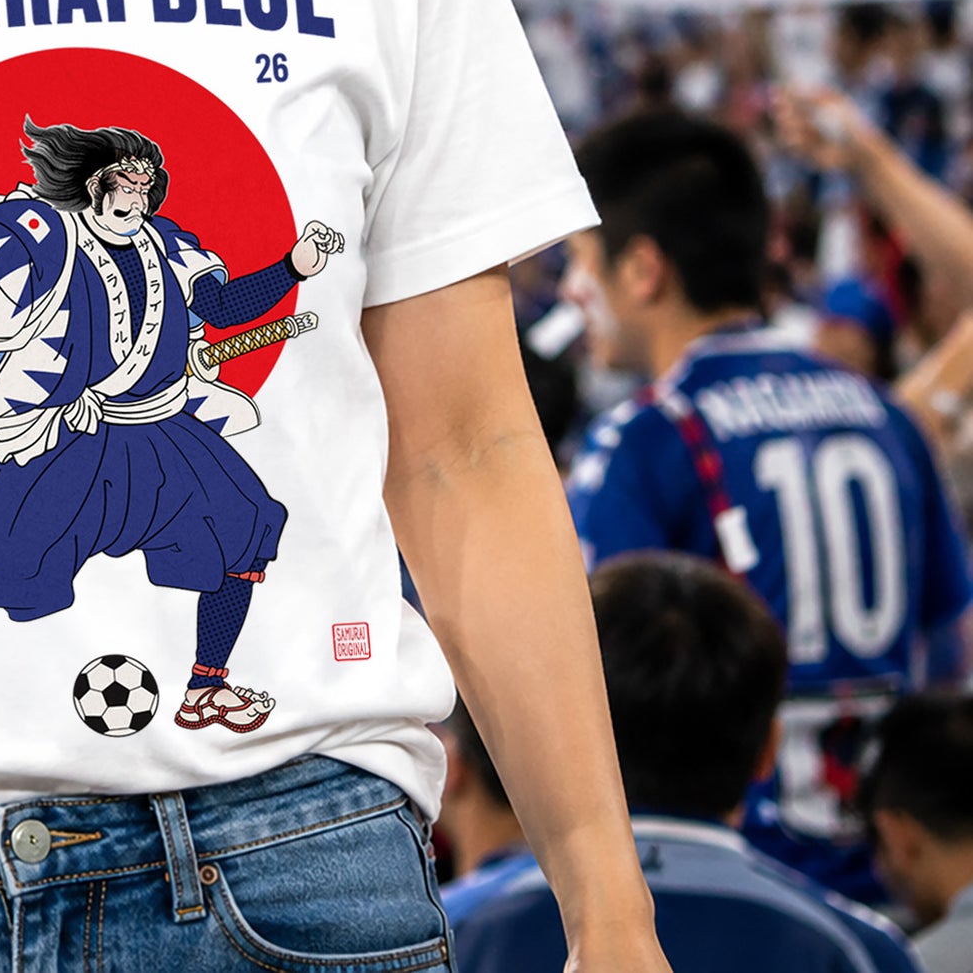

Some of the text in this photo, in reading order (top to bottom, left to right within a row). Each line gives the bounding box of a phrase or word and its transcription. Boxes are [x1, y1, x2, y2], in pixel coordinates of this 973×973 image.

[255, 52, 289, 84] 26
[754, 433, 907, 663] 10
[336, 626, 366, 641] SAMURAI
[337, 642, 369, 657] ORIGINAL
